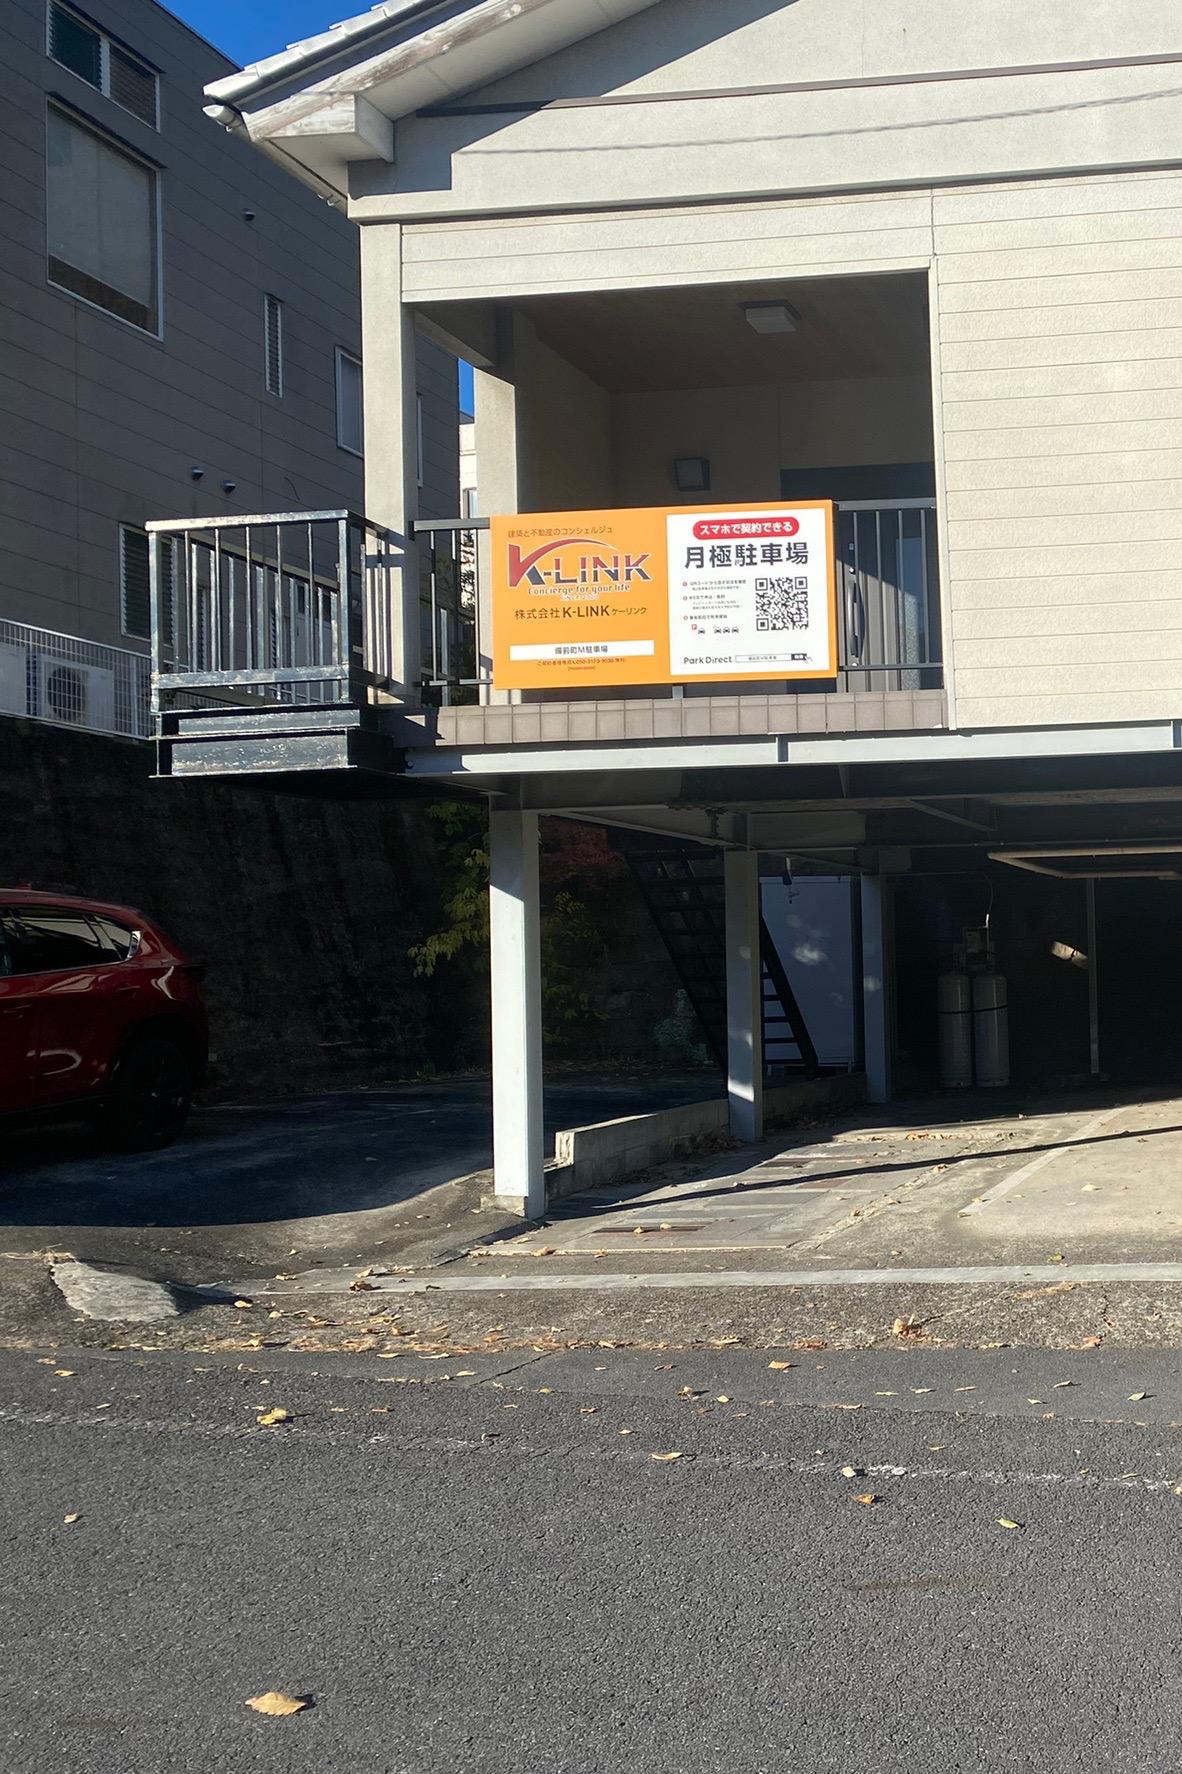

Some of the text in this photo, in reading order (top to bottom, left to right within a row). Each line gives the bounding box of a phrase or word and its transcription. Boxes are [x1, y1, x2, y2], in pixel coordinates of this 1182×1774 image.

[699, 521, 794, 536] スマホで契約できる
[508, 538, 652, 588] K-LINK
[684, 541, 810, 570] 月極駐車場
[576, 585, 590, 593] for
[591, 584, 613, 594] your
[614, 584, 631, 592] life
[683, 655, 733, 665] Park Direct
